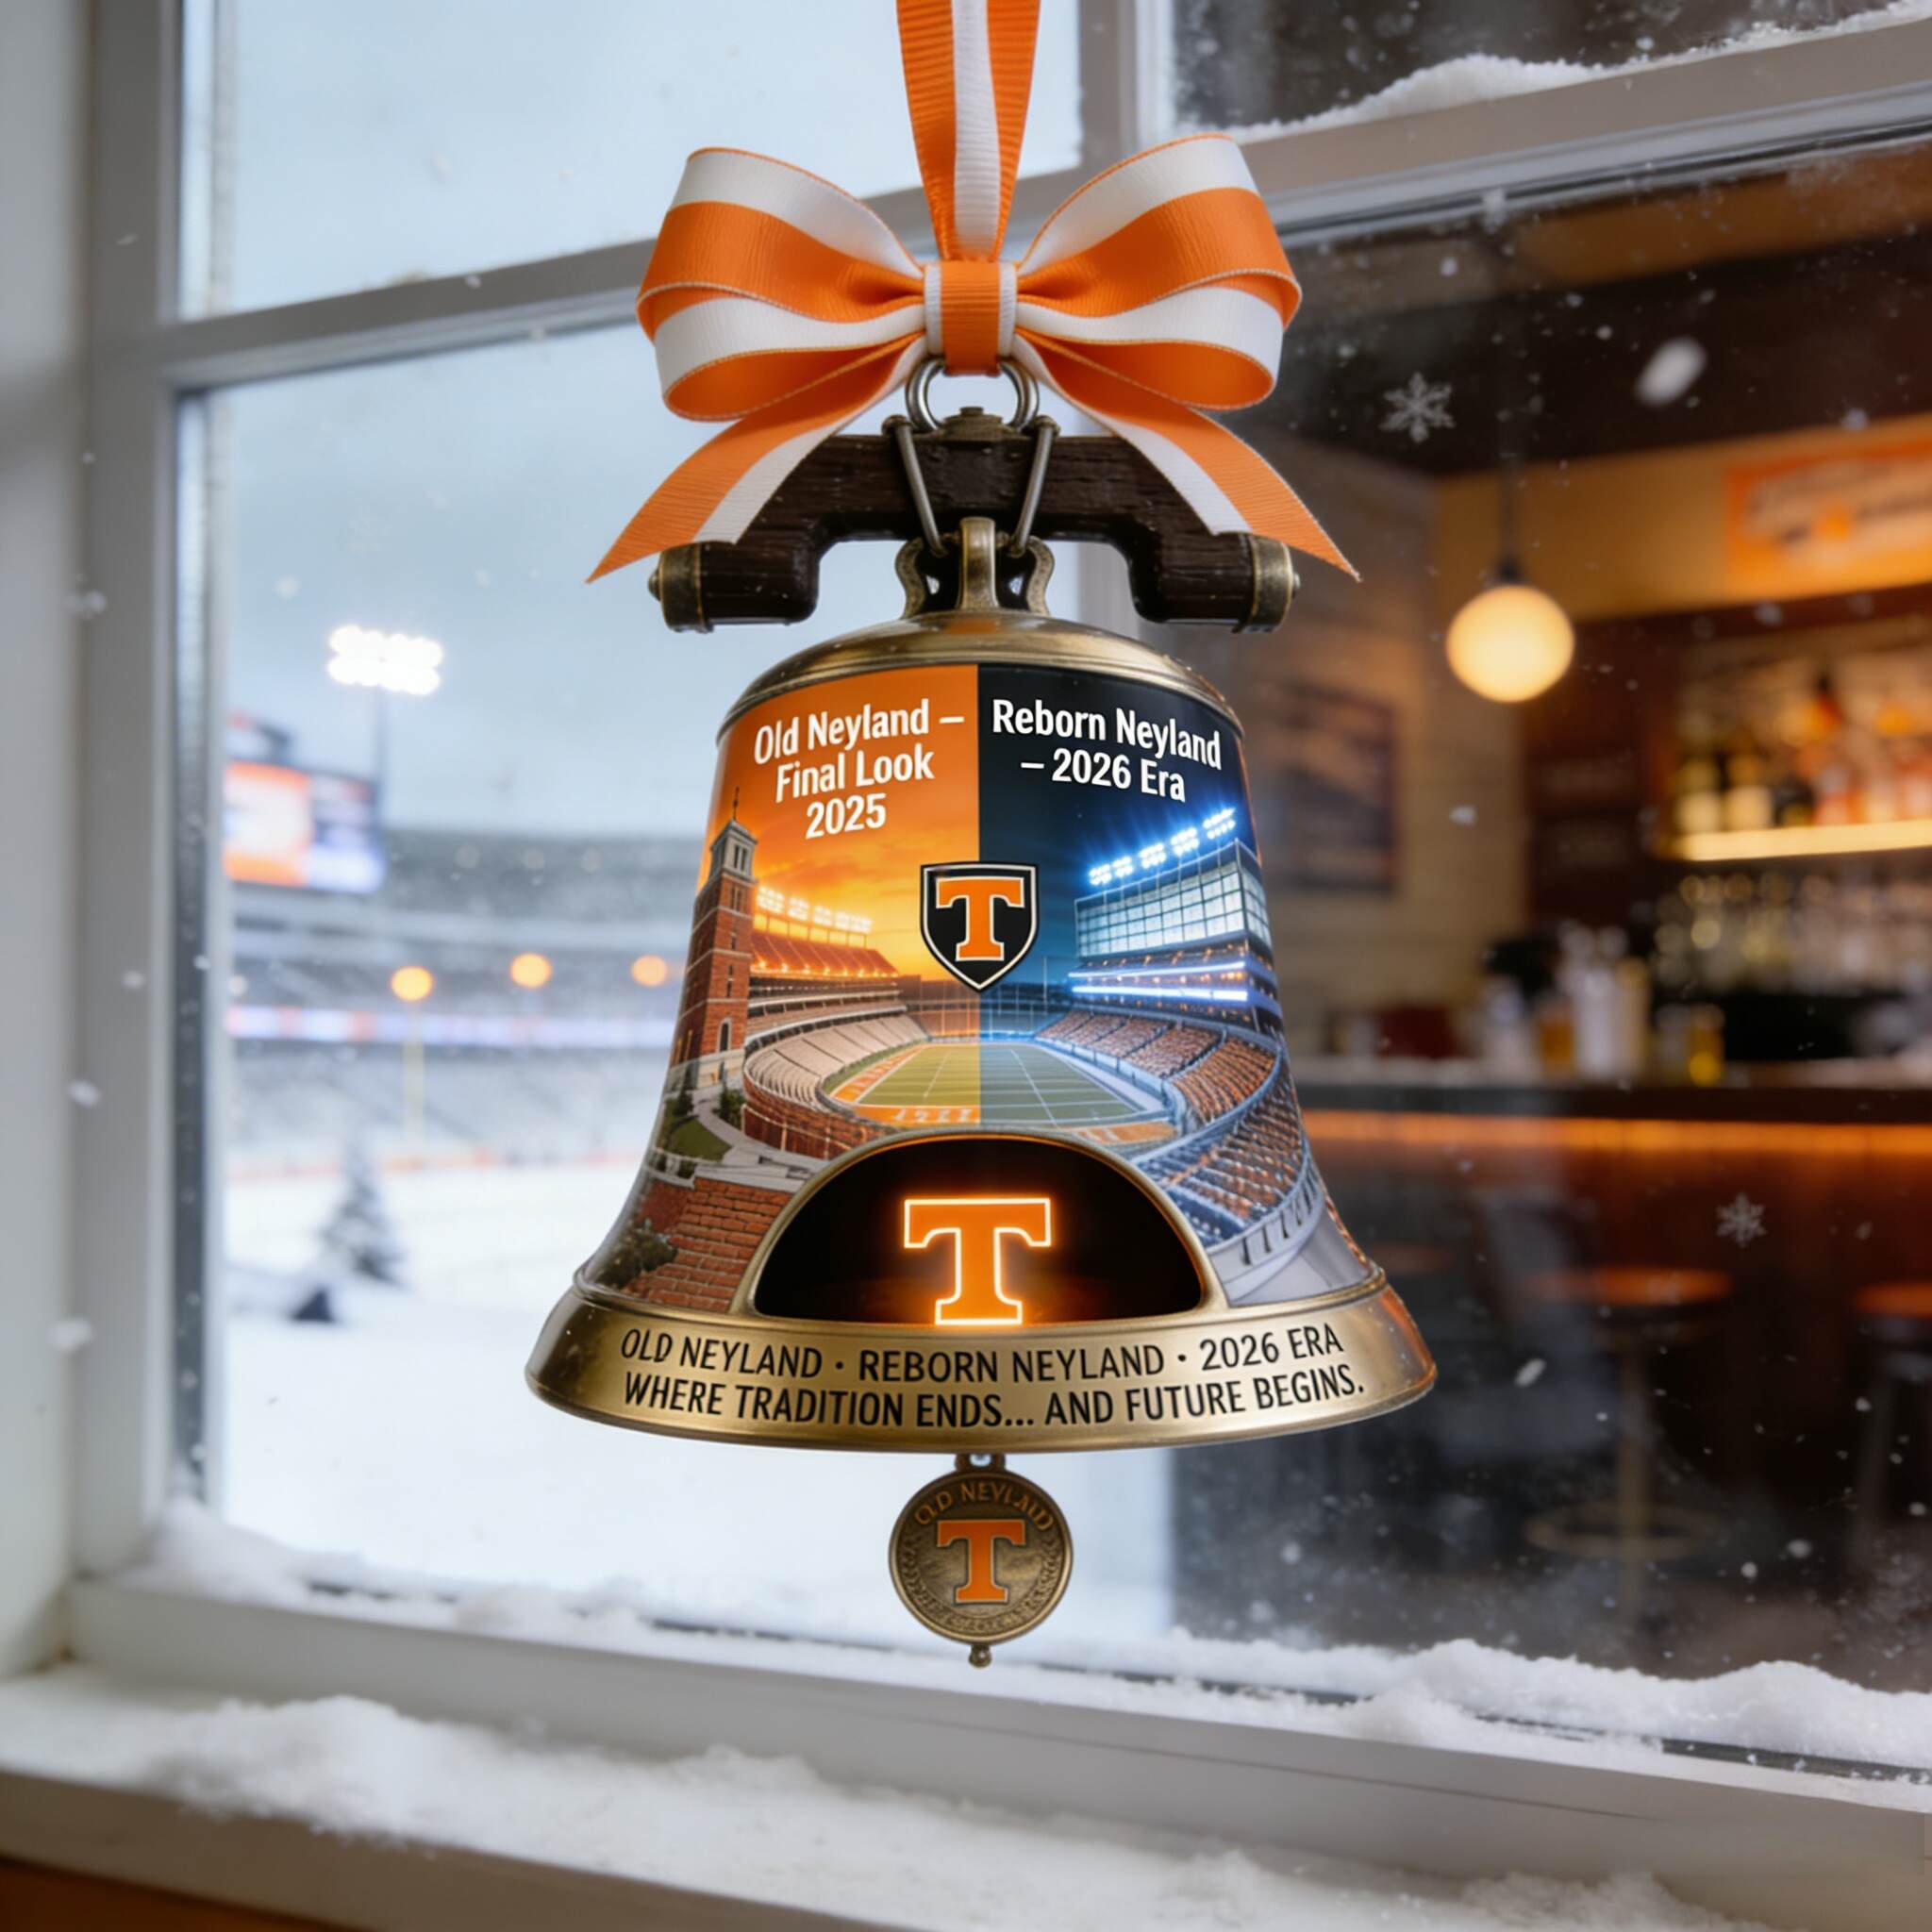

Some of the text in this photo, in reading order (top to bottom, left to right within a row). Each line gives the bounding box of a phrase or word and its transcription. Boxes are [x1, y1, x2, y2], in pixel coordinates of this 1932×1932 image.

[754, 716, 799, 765] Old
[808, 698, 929, 761] Neyland
[992, 698, 1222, 771] Reborn Neyland
[775, 744, 934, 804] Final Look
[1052, 747, 1131, 790] 2026
[1141, 759, 1186, 803] Era
[805, 792, 887, 840] 2025
[936, 876, 1025, 962] T
[902, 1196, 1052, 1327] T
[621, 1328, 673, 1363] OLD
[679, 1336, 823, 1378] NEYLAND
[859, 1350, 998, 1383] REBORN
[1012, 1344, 1165, 1383] NEYLAND
[1199, 1331, 1279, 1371] 2026
[1287, 1323, 1344, 1359] ERA
[625, 1372, 726, 1415] WHERE
[735, 1385, 904, 1426] TRADITION
[1044, 1390, 1113, 1425] AND
[1125, 1381, 1245, 1423] FUTURE
[1253, 1363, 1365, 1410] BEGINS.
[936, 1519, 1026, 1603] T
